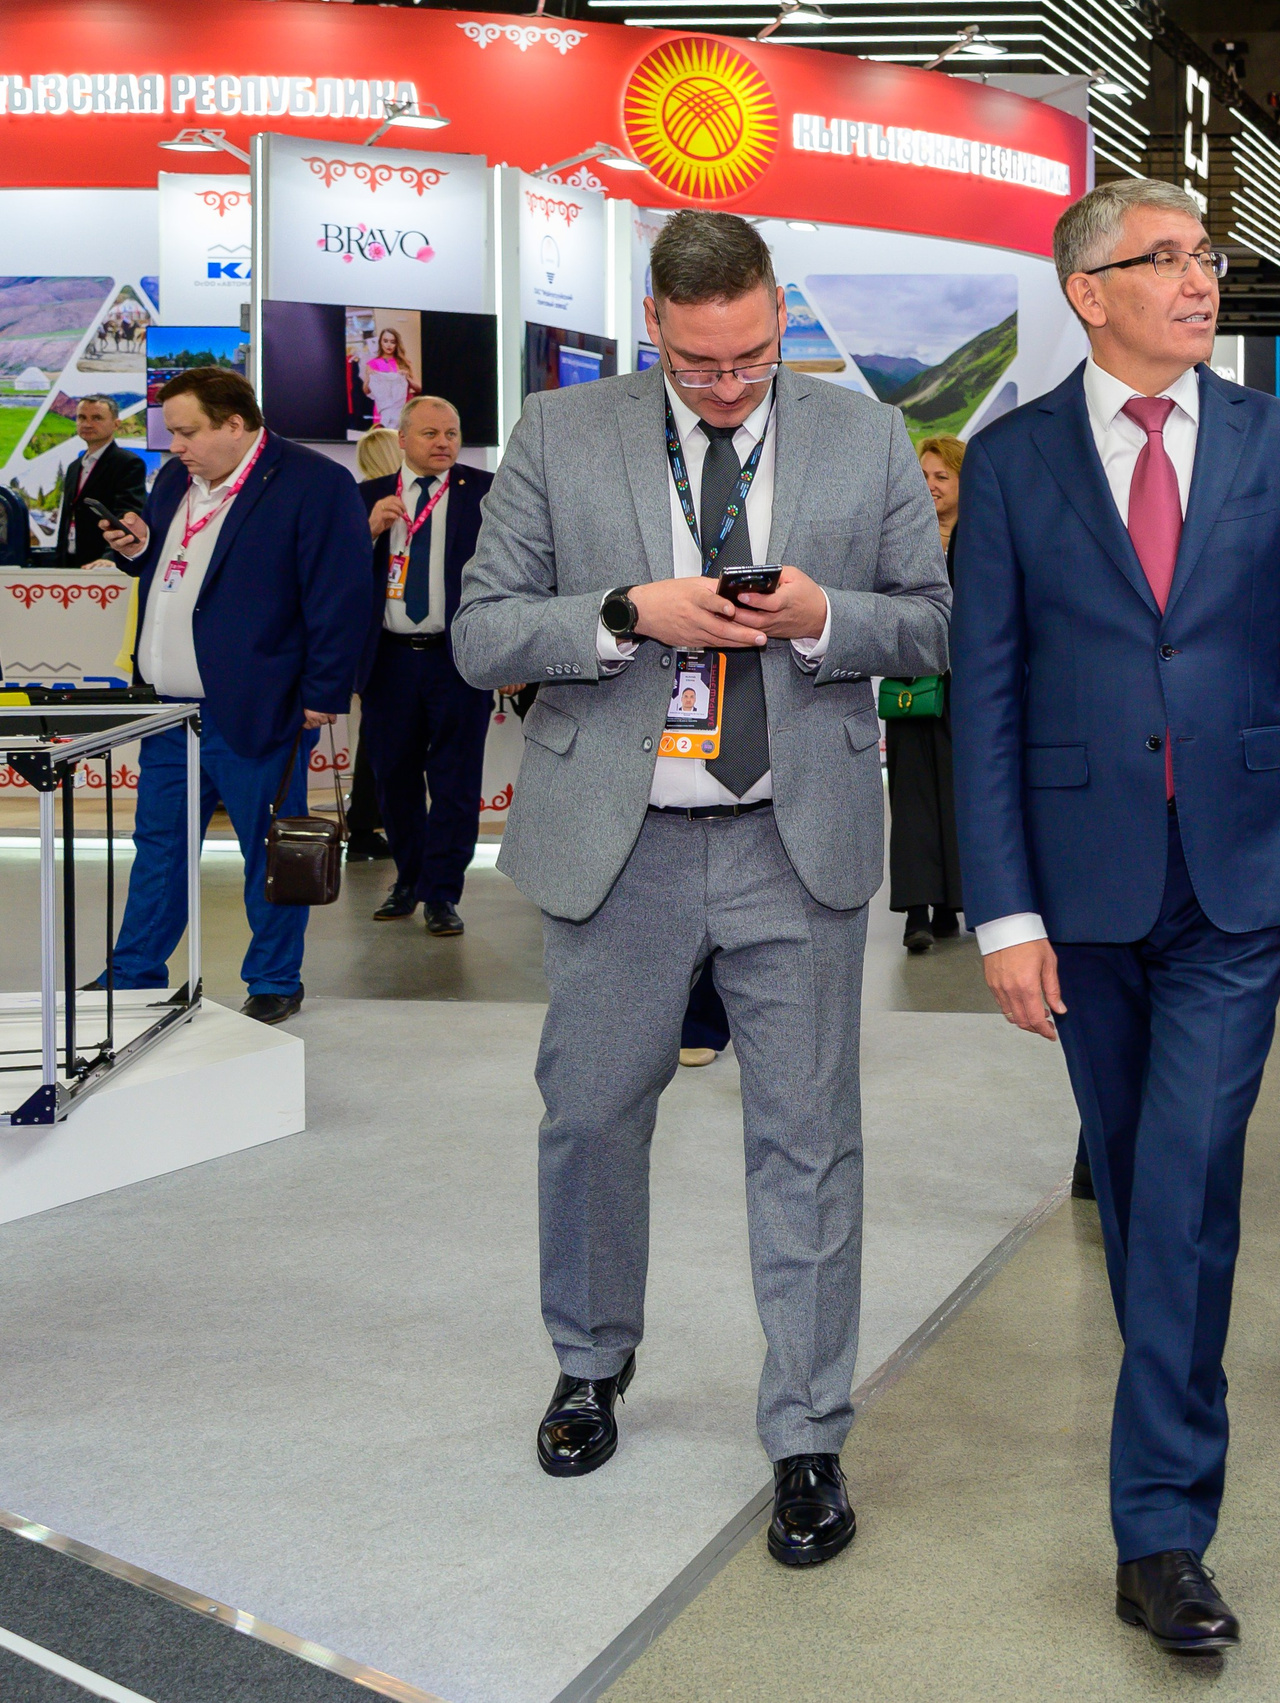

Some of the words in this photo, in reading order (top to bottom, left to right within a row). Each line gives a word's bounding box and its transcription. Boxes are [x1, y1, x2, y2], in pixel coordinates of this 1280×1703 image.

[170, 74, 419, 119] РЕСПУБЛИКА
[793, 113, 970, 173] КЫРГЫЗСКАЯ
[971, 141, 1070, 196] РЕСПУБЛИКА
[320, 223, 430, 262] BRAVO
[681, 740, 688, 749] 2
